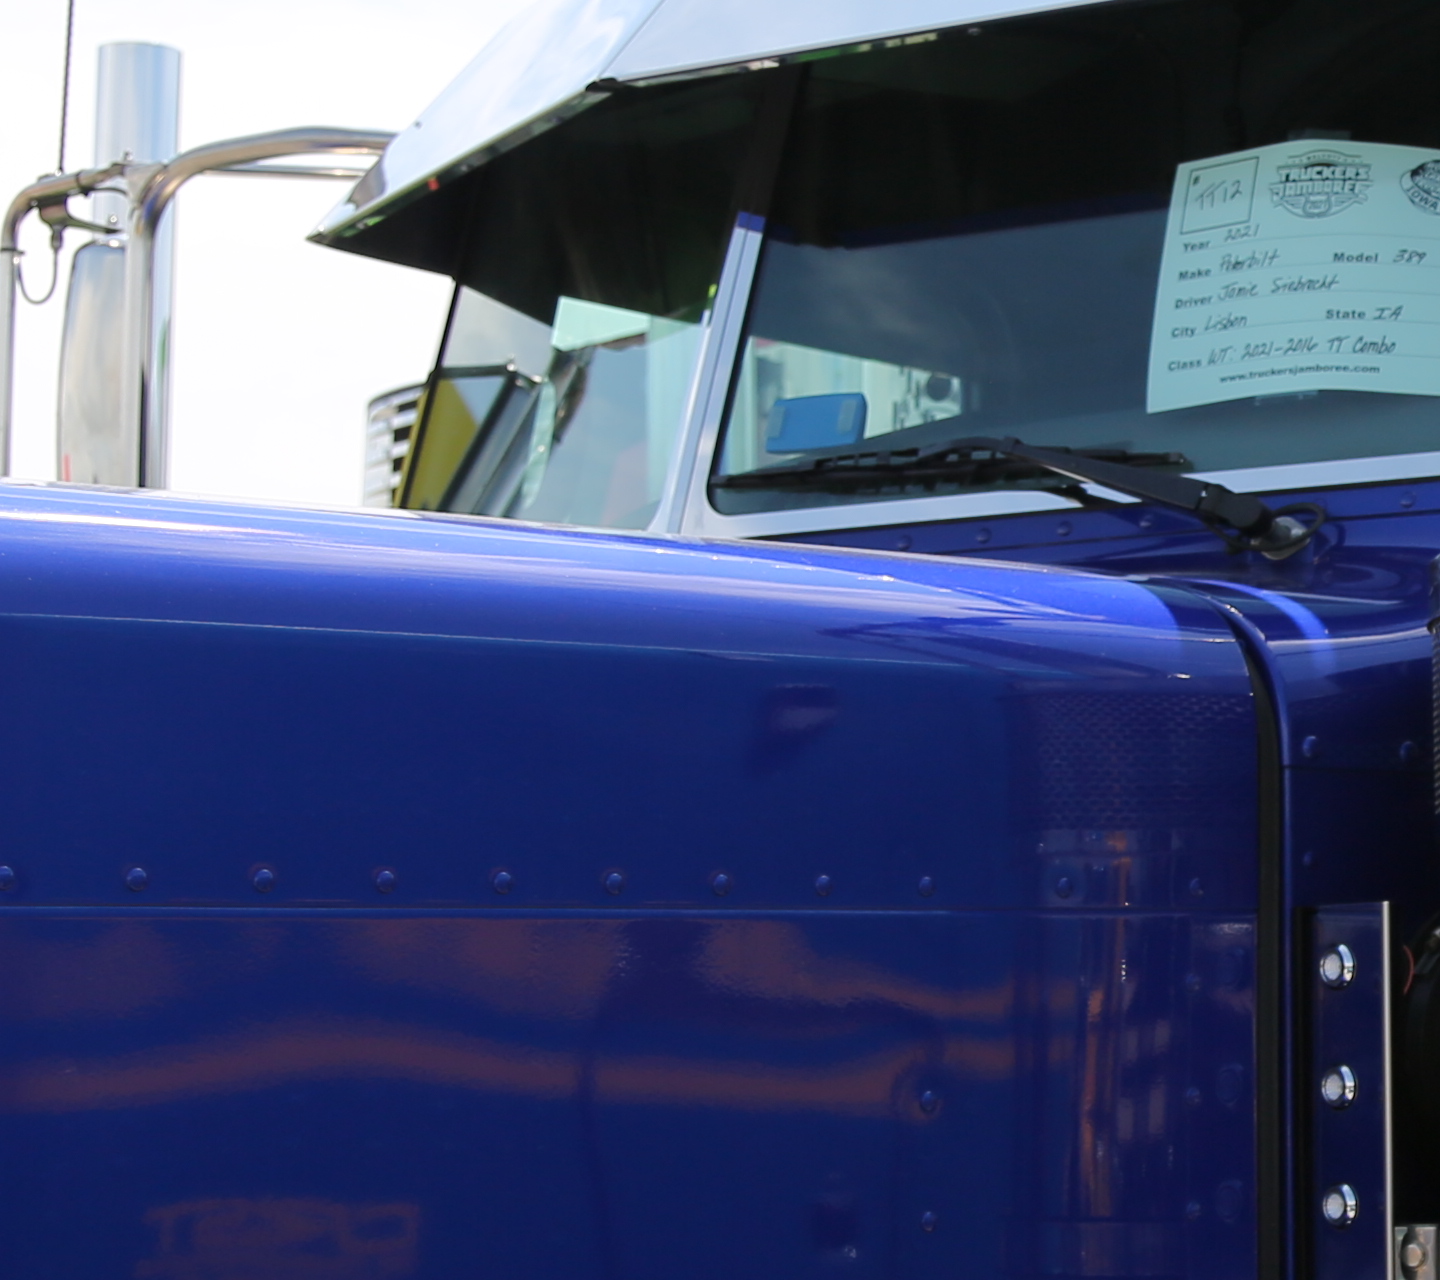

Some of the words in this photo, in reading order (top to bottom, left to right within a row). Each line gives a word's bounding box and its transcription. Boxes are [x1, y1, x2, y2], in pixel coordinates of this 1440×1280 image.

[1279, 166, 1371, 182] TRUCKERS
[1271, 180, 1364, 199] JAMBOREE
[1406, 186, 1439, 211] IOWA
[1183, 241, 1210, 252] Year
[1224, 224, 1260, 242] 2021
[1178, 268, 1211, 280] Make
[1333, 252, 1378, 263] Model
[1393, 249, 1427, 264] 389
[1174, 296, 1213, 309] Driver
[1218, 281, 1259, 301] Jamie
[1171, 327, 1197, 339] City
[1204, 312, 1248, 331] Lisbon
[1325, 309, 1366, 320] State
[1373, 305, 1404, 320] IA
[1168, 360, 1202, 371] Class
[1327, 335, 1350, 353] TT
[1352, 335, 1396, 354] Combo
[1219, 364, 1380, 383] www.truckersjamboree.com
